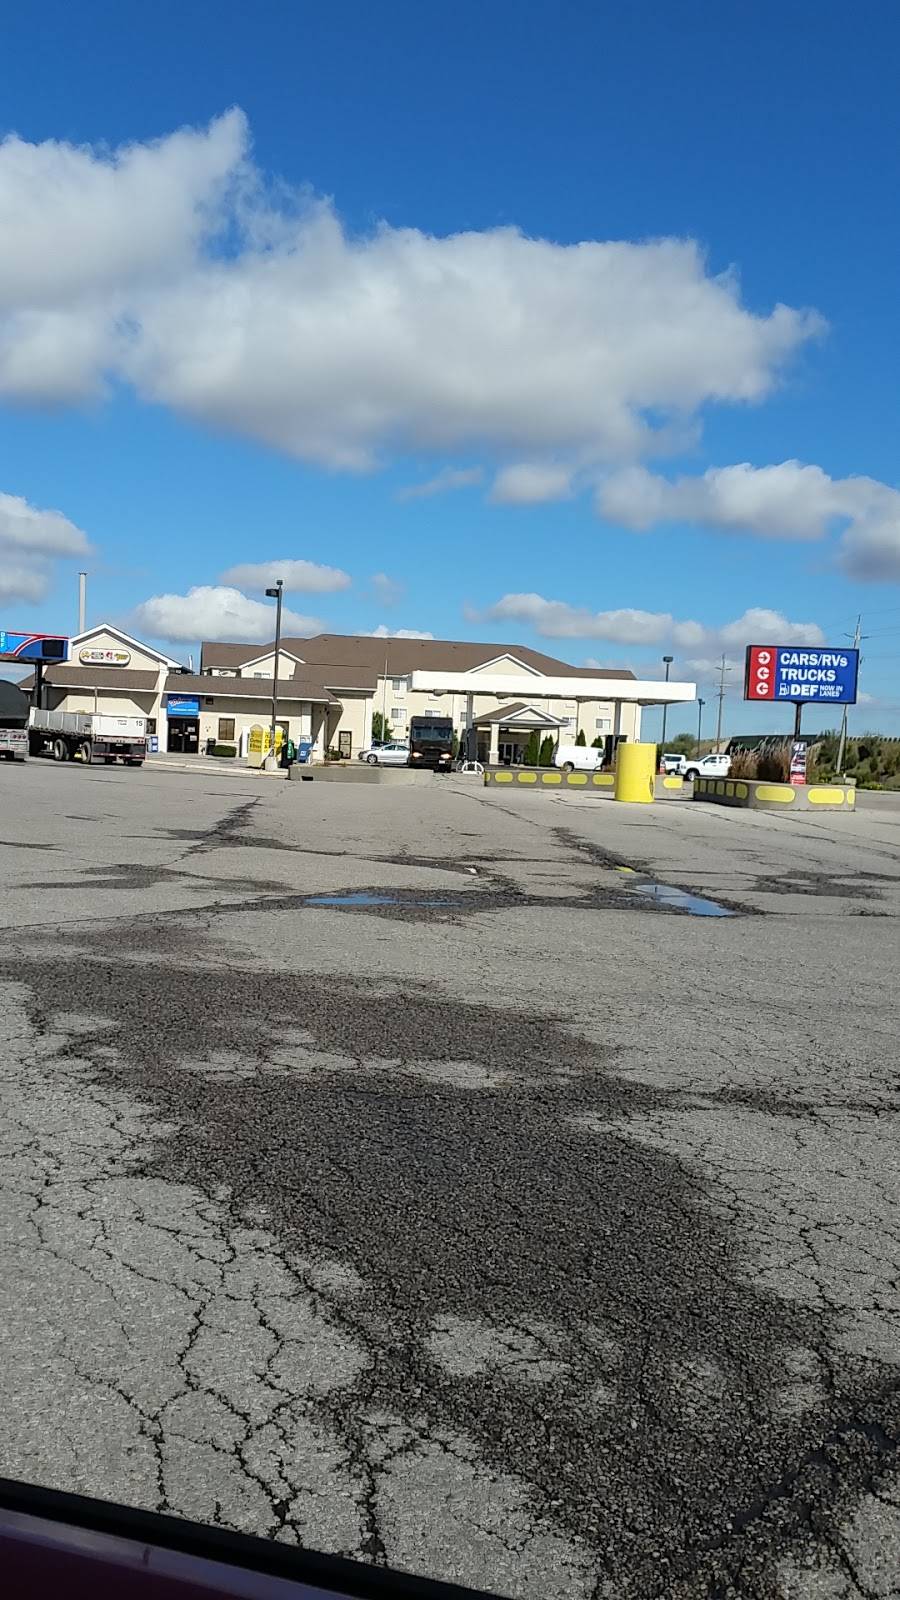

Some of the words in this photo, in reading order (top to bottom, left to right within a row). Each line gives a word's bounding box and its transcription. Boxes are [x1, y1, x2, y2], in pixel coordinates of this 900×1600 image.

[781, 653, 848, 667] CARS/RVs
[780, 668, 836, 681] TRUCKS
[791, 684, 819, 696] DEF
